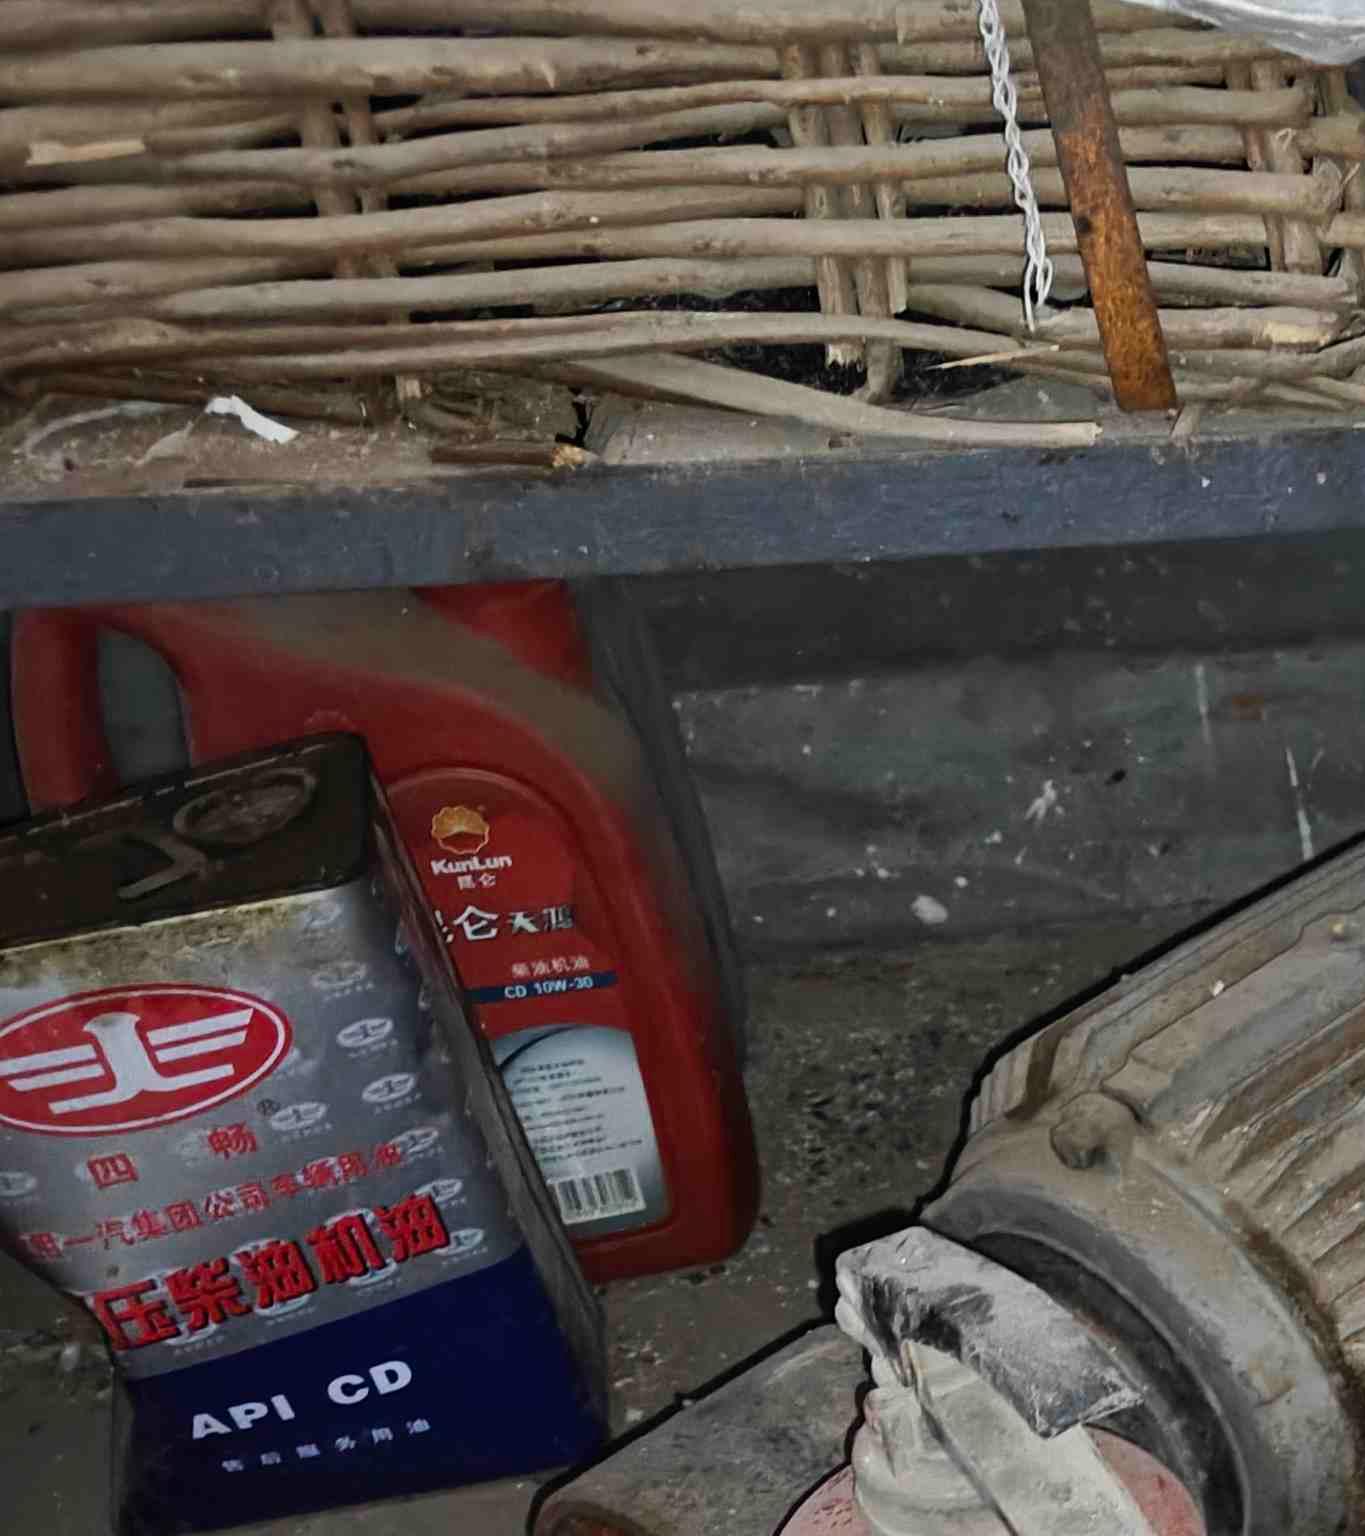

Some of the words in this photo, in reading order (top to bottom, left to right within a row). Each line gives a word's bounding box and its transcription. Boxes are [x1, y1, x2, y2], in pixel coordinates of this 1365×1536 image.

[430, 855, 513, 876] KunLun
[503, 984, 528, 999] CD
[533, 975, 594, 996] 10W-30
[191, 1394, 295, 1440] API
[326, 1359, 413, 1405] CD
